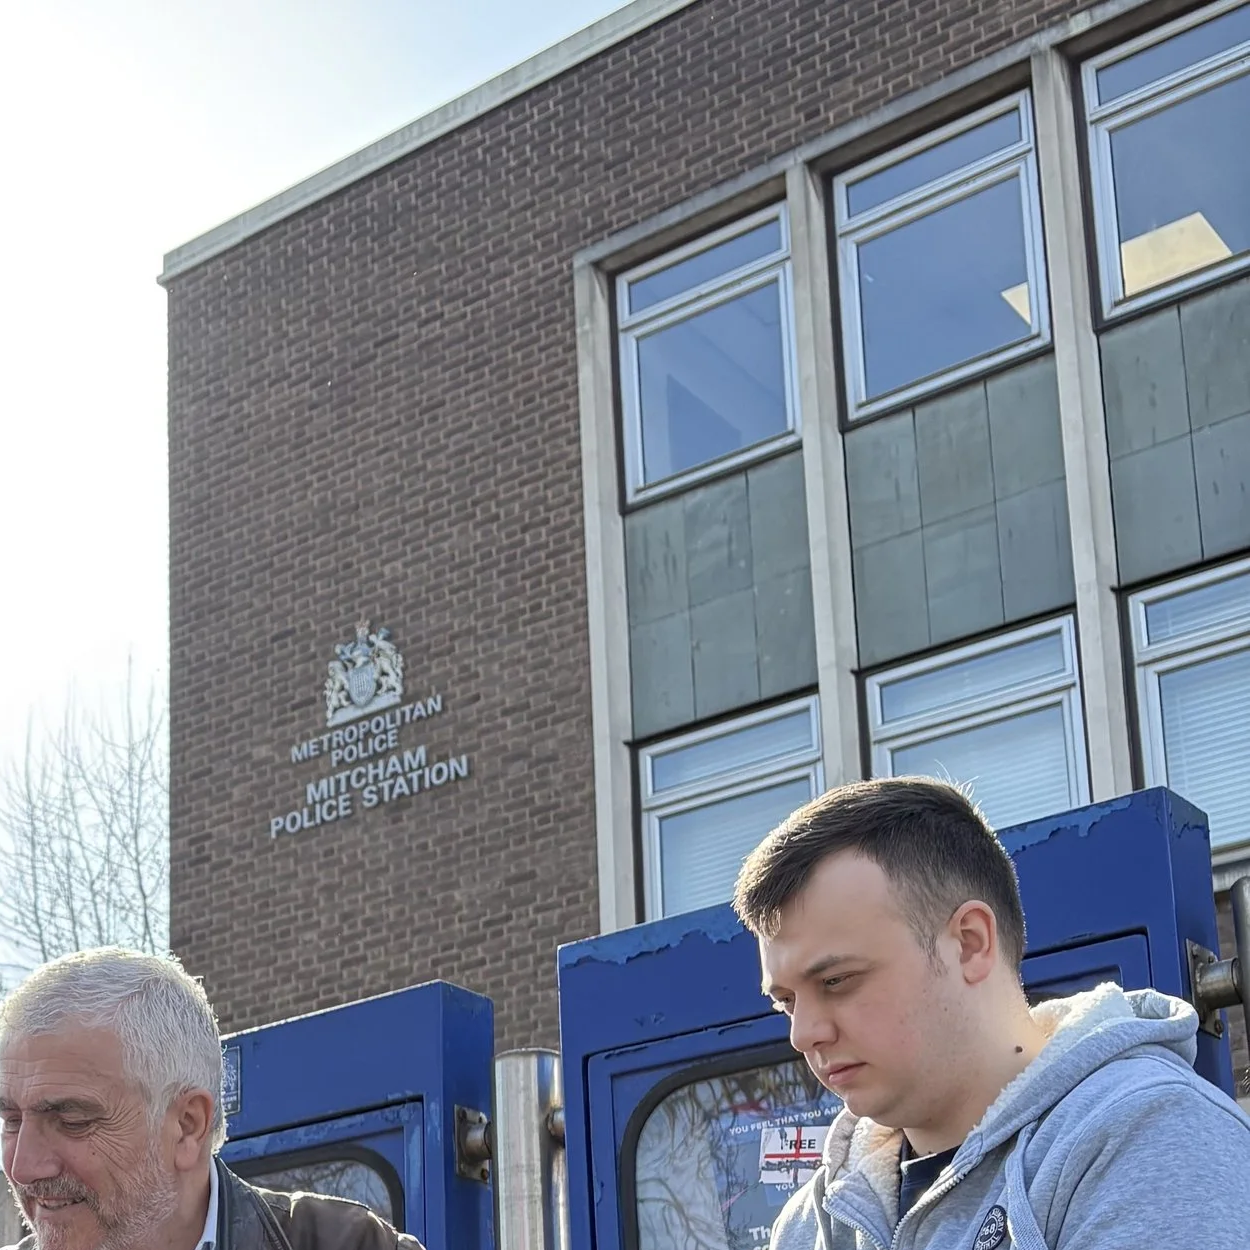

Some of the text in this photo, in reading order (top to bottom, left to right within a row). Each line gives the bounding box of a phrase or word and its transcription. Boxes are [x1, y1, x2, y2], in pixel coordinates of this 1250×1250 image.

[290, 693, 443, 763] METROPOLITAN
[330, 729, 399, 768] POLICE
[269, 754, 469, 839] POLICE STATION
[306, 745, 427, 805] MITCHAM
[729, 1125, 749, 1136] YOU
[750, 1119, 774, 1130] FEEL
[775, 1114, 799, 1126] THAT
[801, 1109, 821, 1120] YOU
